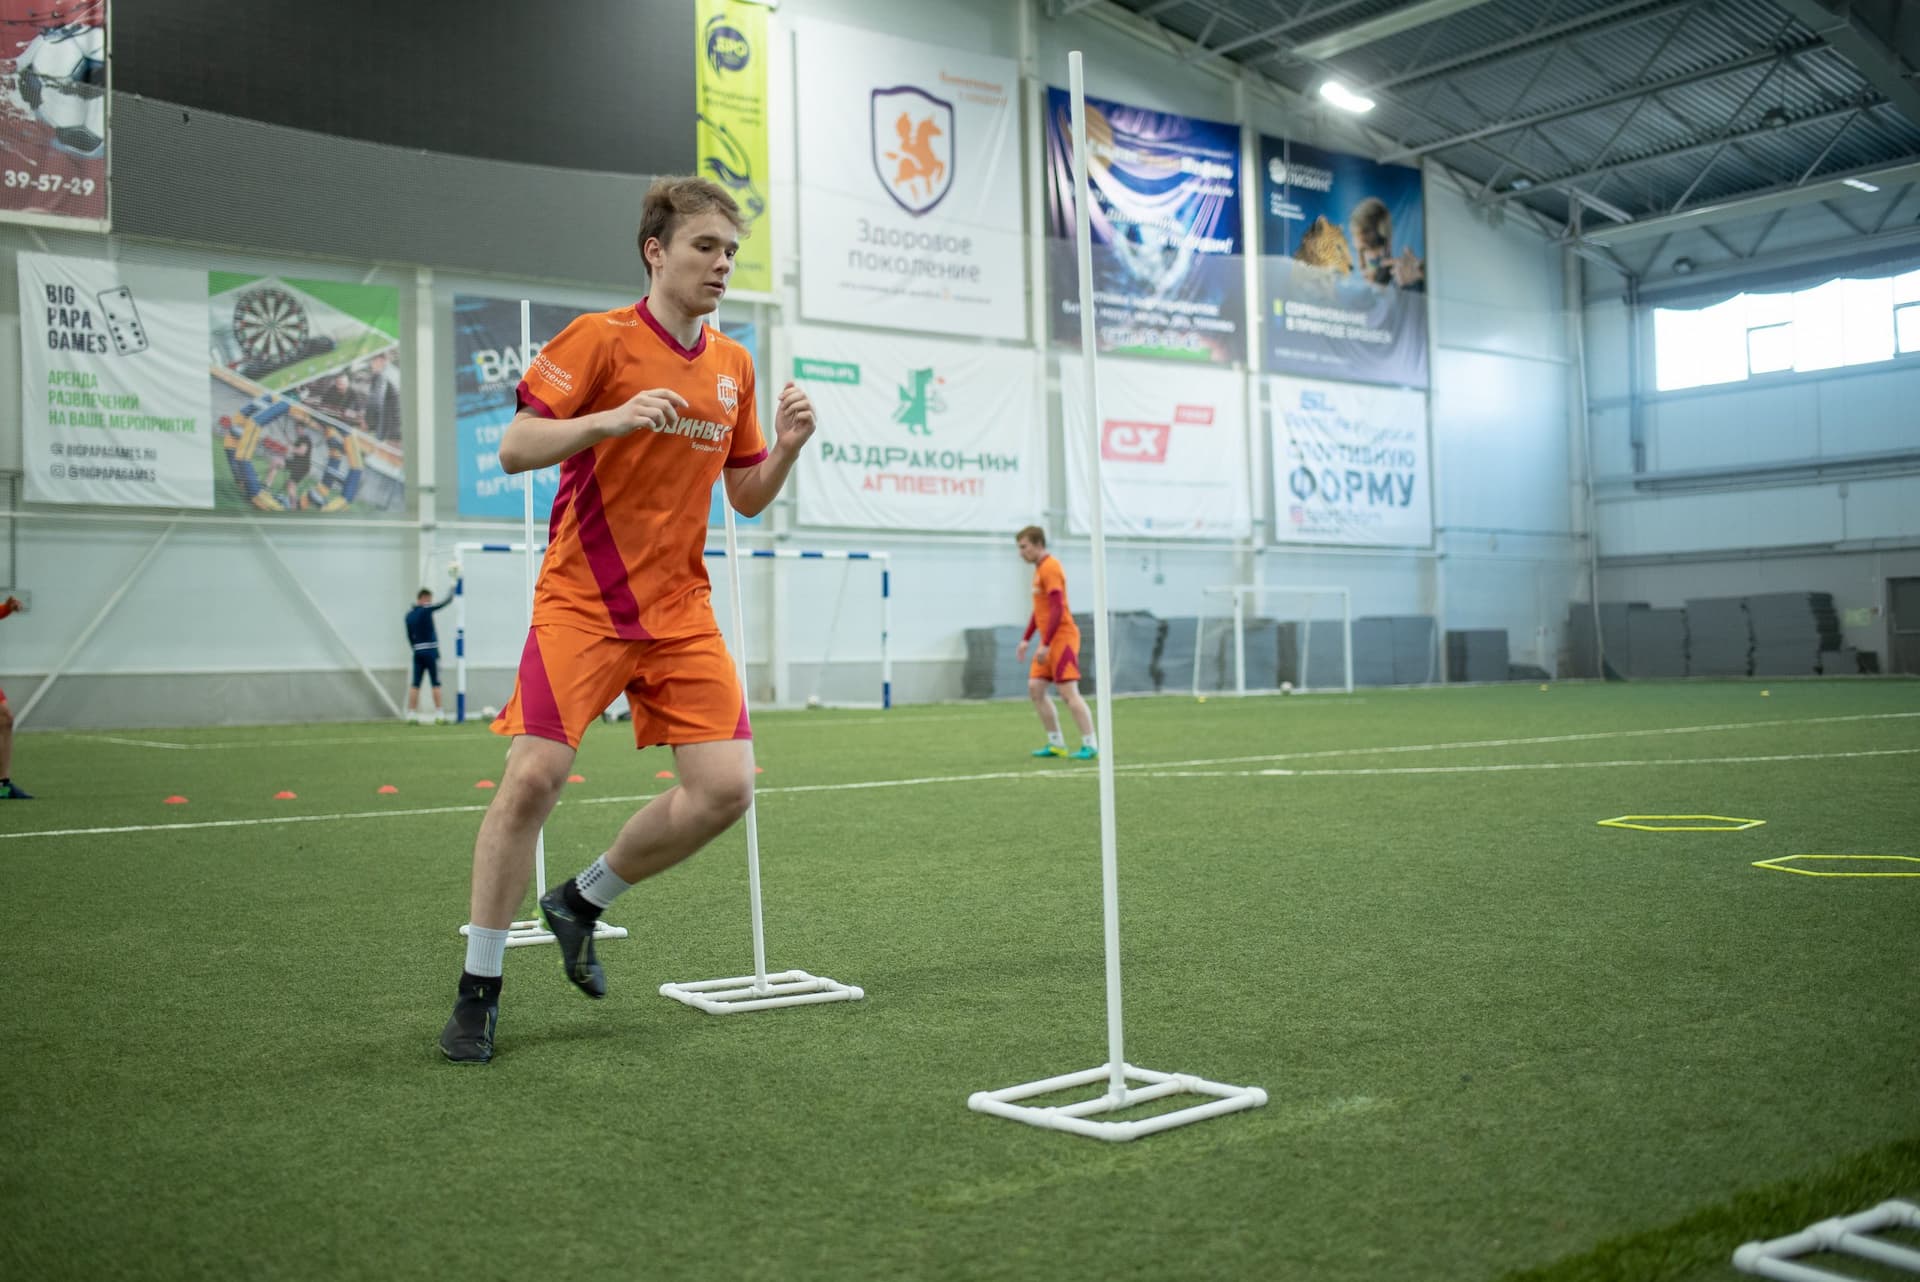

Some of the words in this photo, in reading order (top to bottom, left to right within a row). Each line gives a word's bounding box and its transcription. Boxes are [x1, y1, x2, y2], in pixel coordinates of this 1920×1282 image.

[5, 170, 95, 196] 39-57-29
[856, 218, 972, 255] Здоровое
[849, 250, 980, 283] поколение
[46, 284, 75, 306] BIG
[47, 307, 93, 329] PAPA
[48, 330, 107, 354] GAMES
[48, 369, 98, 388] АРЕНДА
[48, 390, 140, 410] РАЗВЛЕЧЕНИЙ
[48, 410, 66, 425] НА
[69, 411, 105, 429] ВАШЕ
[109, 414, 196, 433] МЕРОПРИЯТИЕ
[821, 442, 1019, 472] РАЗДРАКОНИМ
[862, 473, 984, 497] АППЕТИТ!
[1289, 466, 1415, 507] ФОРМУ
